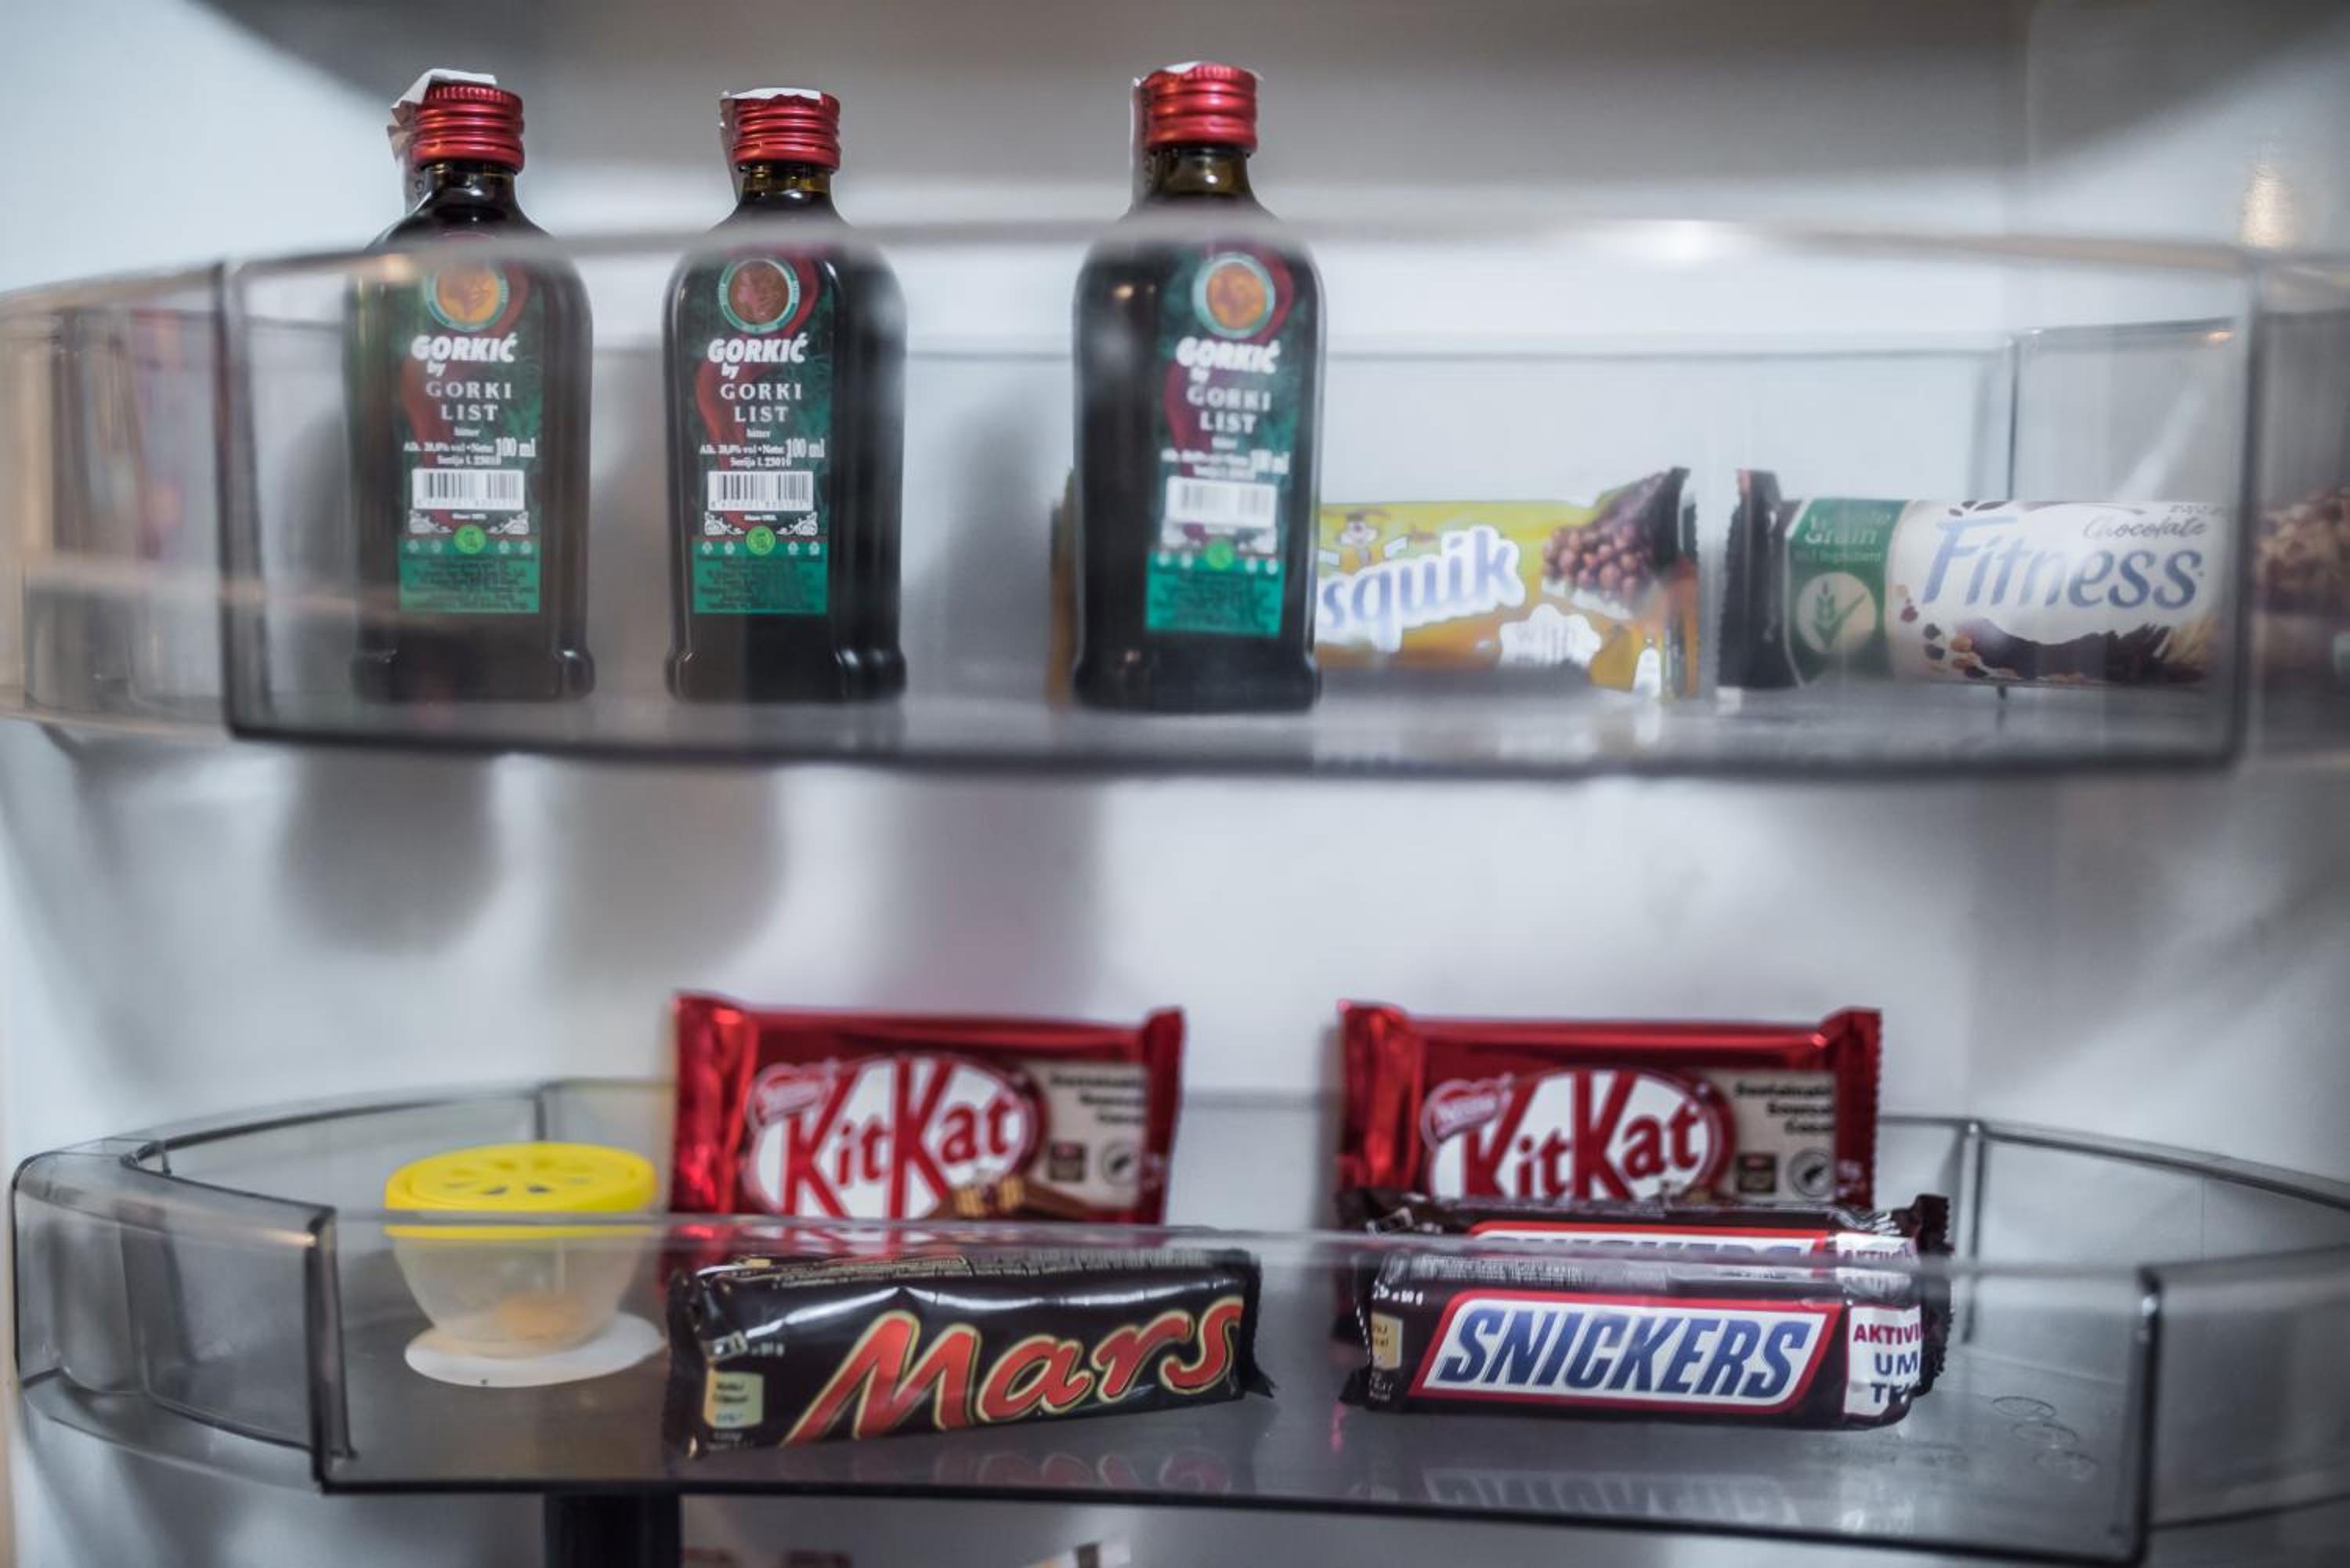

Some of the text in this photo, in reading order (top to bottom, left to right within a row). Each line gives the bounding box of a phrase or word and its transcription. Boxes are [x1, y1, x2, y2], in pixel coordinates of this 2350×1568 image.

[410, 334, 518, 363] GORKIĆ
[707, 333, 808, 363] GORKIĆ
[1176, 337, 1281, 374] GORKIĆ
[721, 363, 739, 378] by
[425, 381, 512, 399] GORKI
[720, 383, 802, 400] GORKI
[1187, 386, 1271, 411] GORKI
[441, 405, 499, 421] LIST
[734, 406, 789, 422] LIST
[1199, 412, 1257, 433] LIST
[786, 438, 807, 459] 100
[808, 438, 825, 458] ml
[1921, 517, 2203, 610] Fitness
[1322, 529, 1510, 652] squik
[784, 1057, 1021, 1219] KitKat
[1462, 1070, 1700, 1199] KitKat
[1853, 1322, 1922, 1345] AKTIVI
[1437, 1307, 1812, 1401] SNICKERS
[1875, 1351, 1918, 1376] UM
[780, 1295, 1245, 1447] Mars
